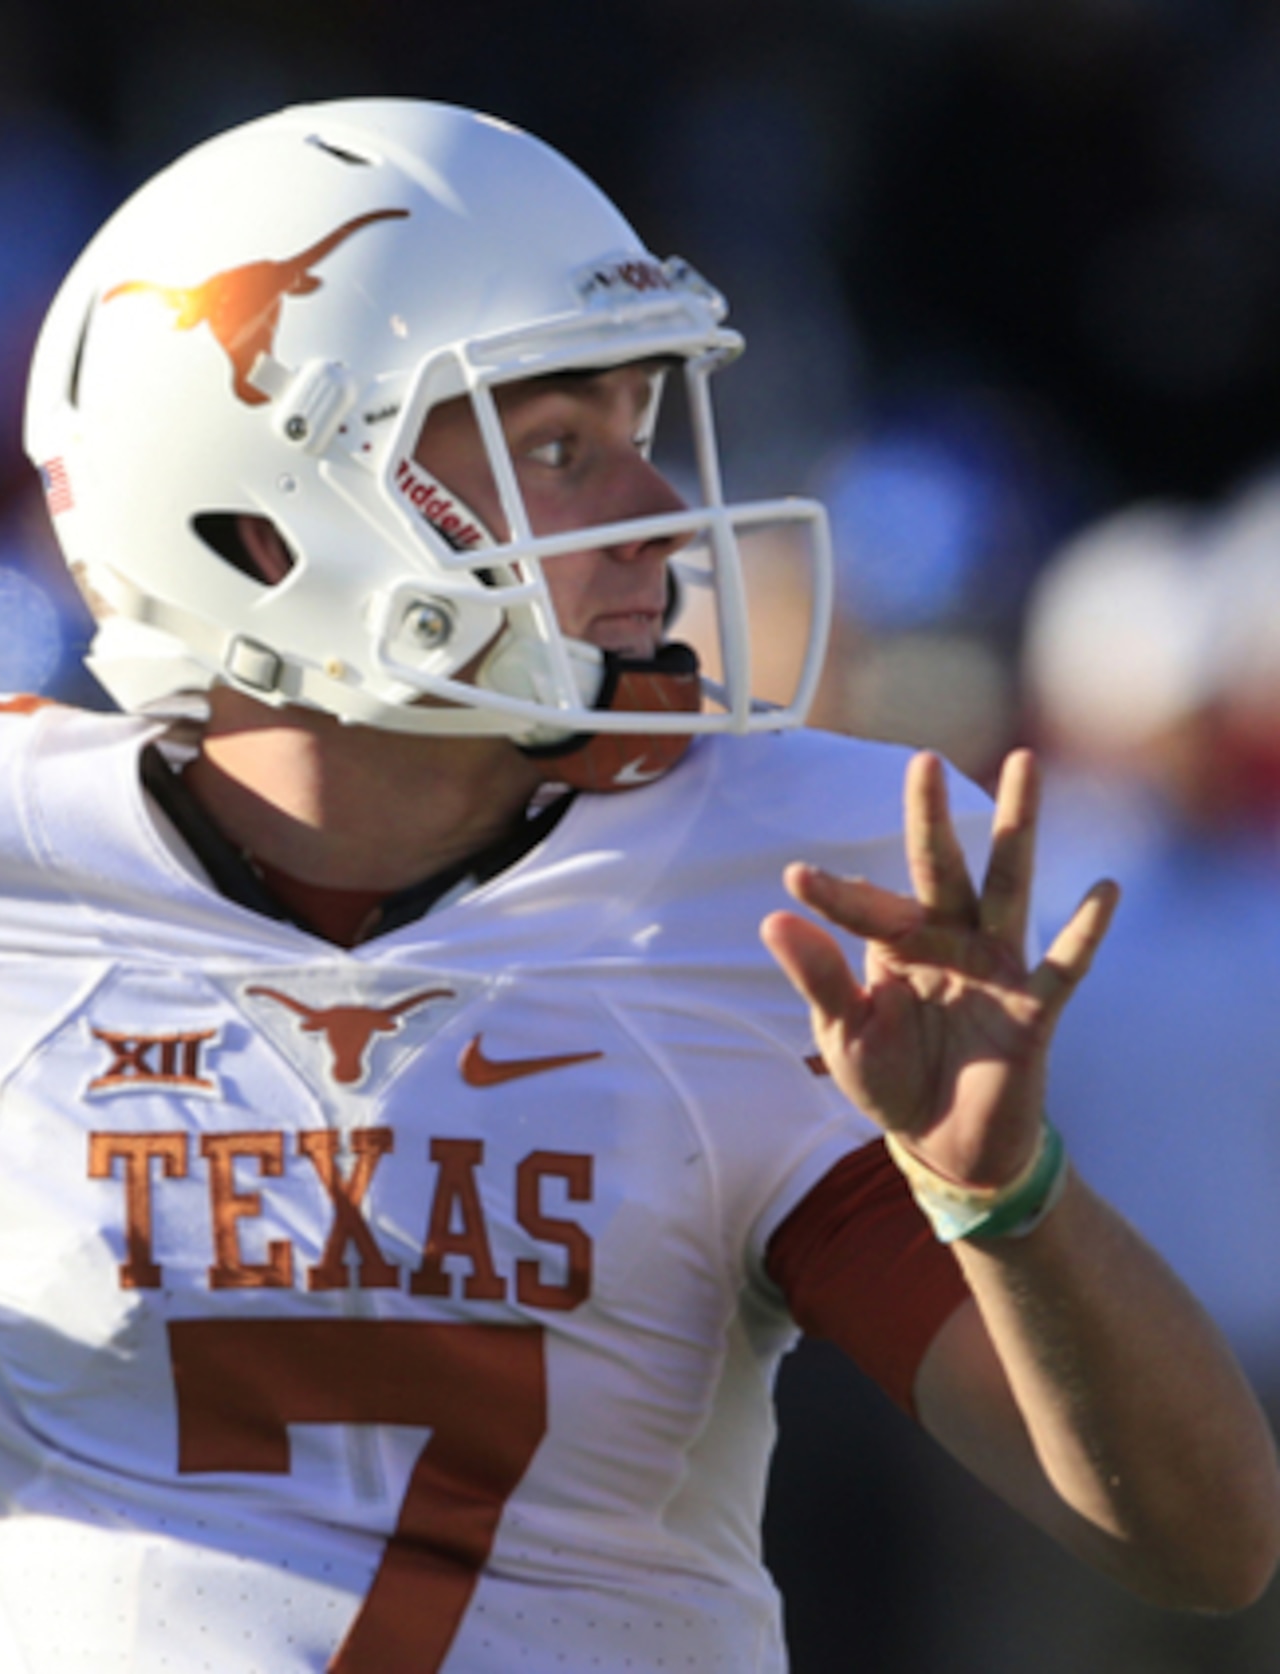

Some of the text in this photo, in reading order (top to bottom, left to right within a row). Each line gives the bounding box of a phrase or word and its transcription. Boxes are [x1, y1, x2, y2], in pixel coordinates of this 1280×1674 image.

[89, 1027, 217, 1090] XII
[88, 1127, 595, 1312] TEXAS
[166, 1318, 549, 1674] 7
